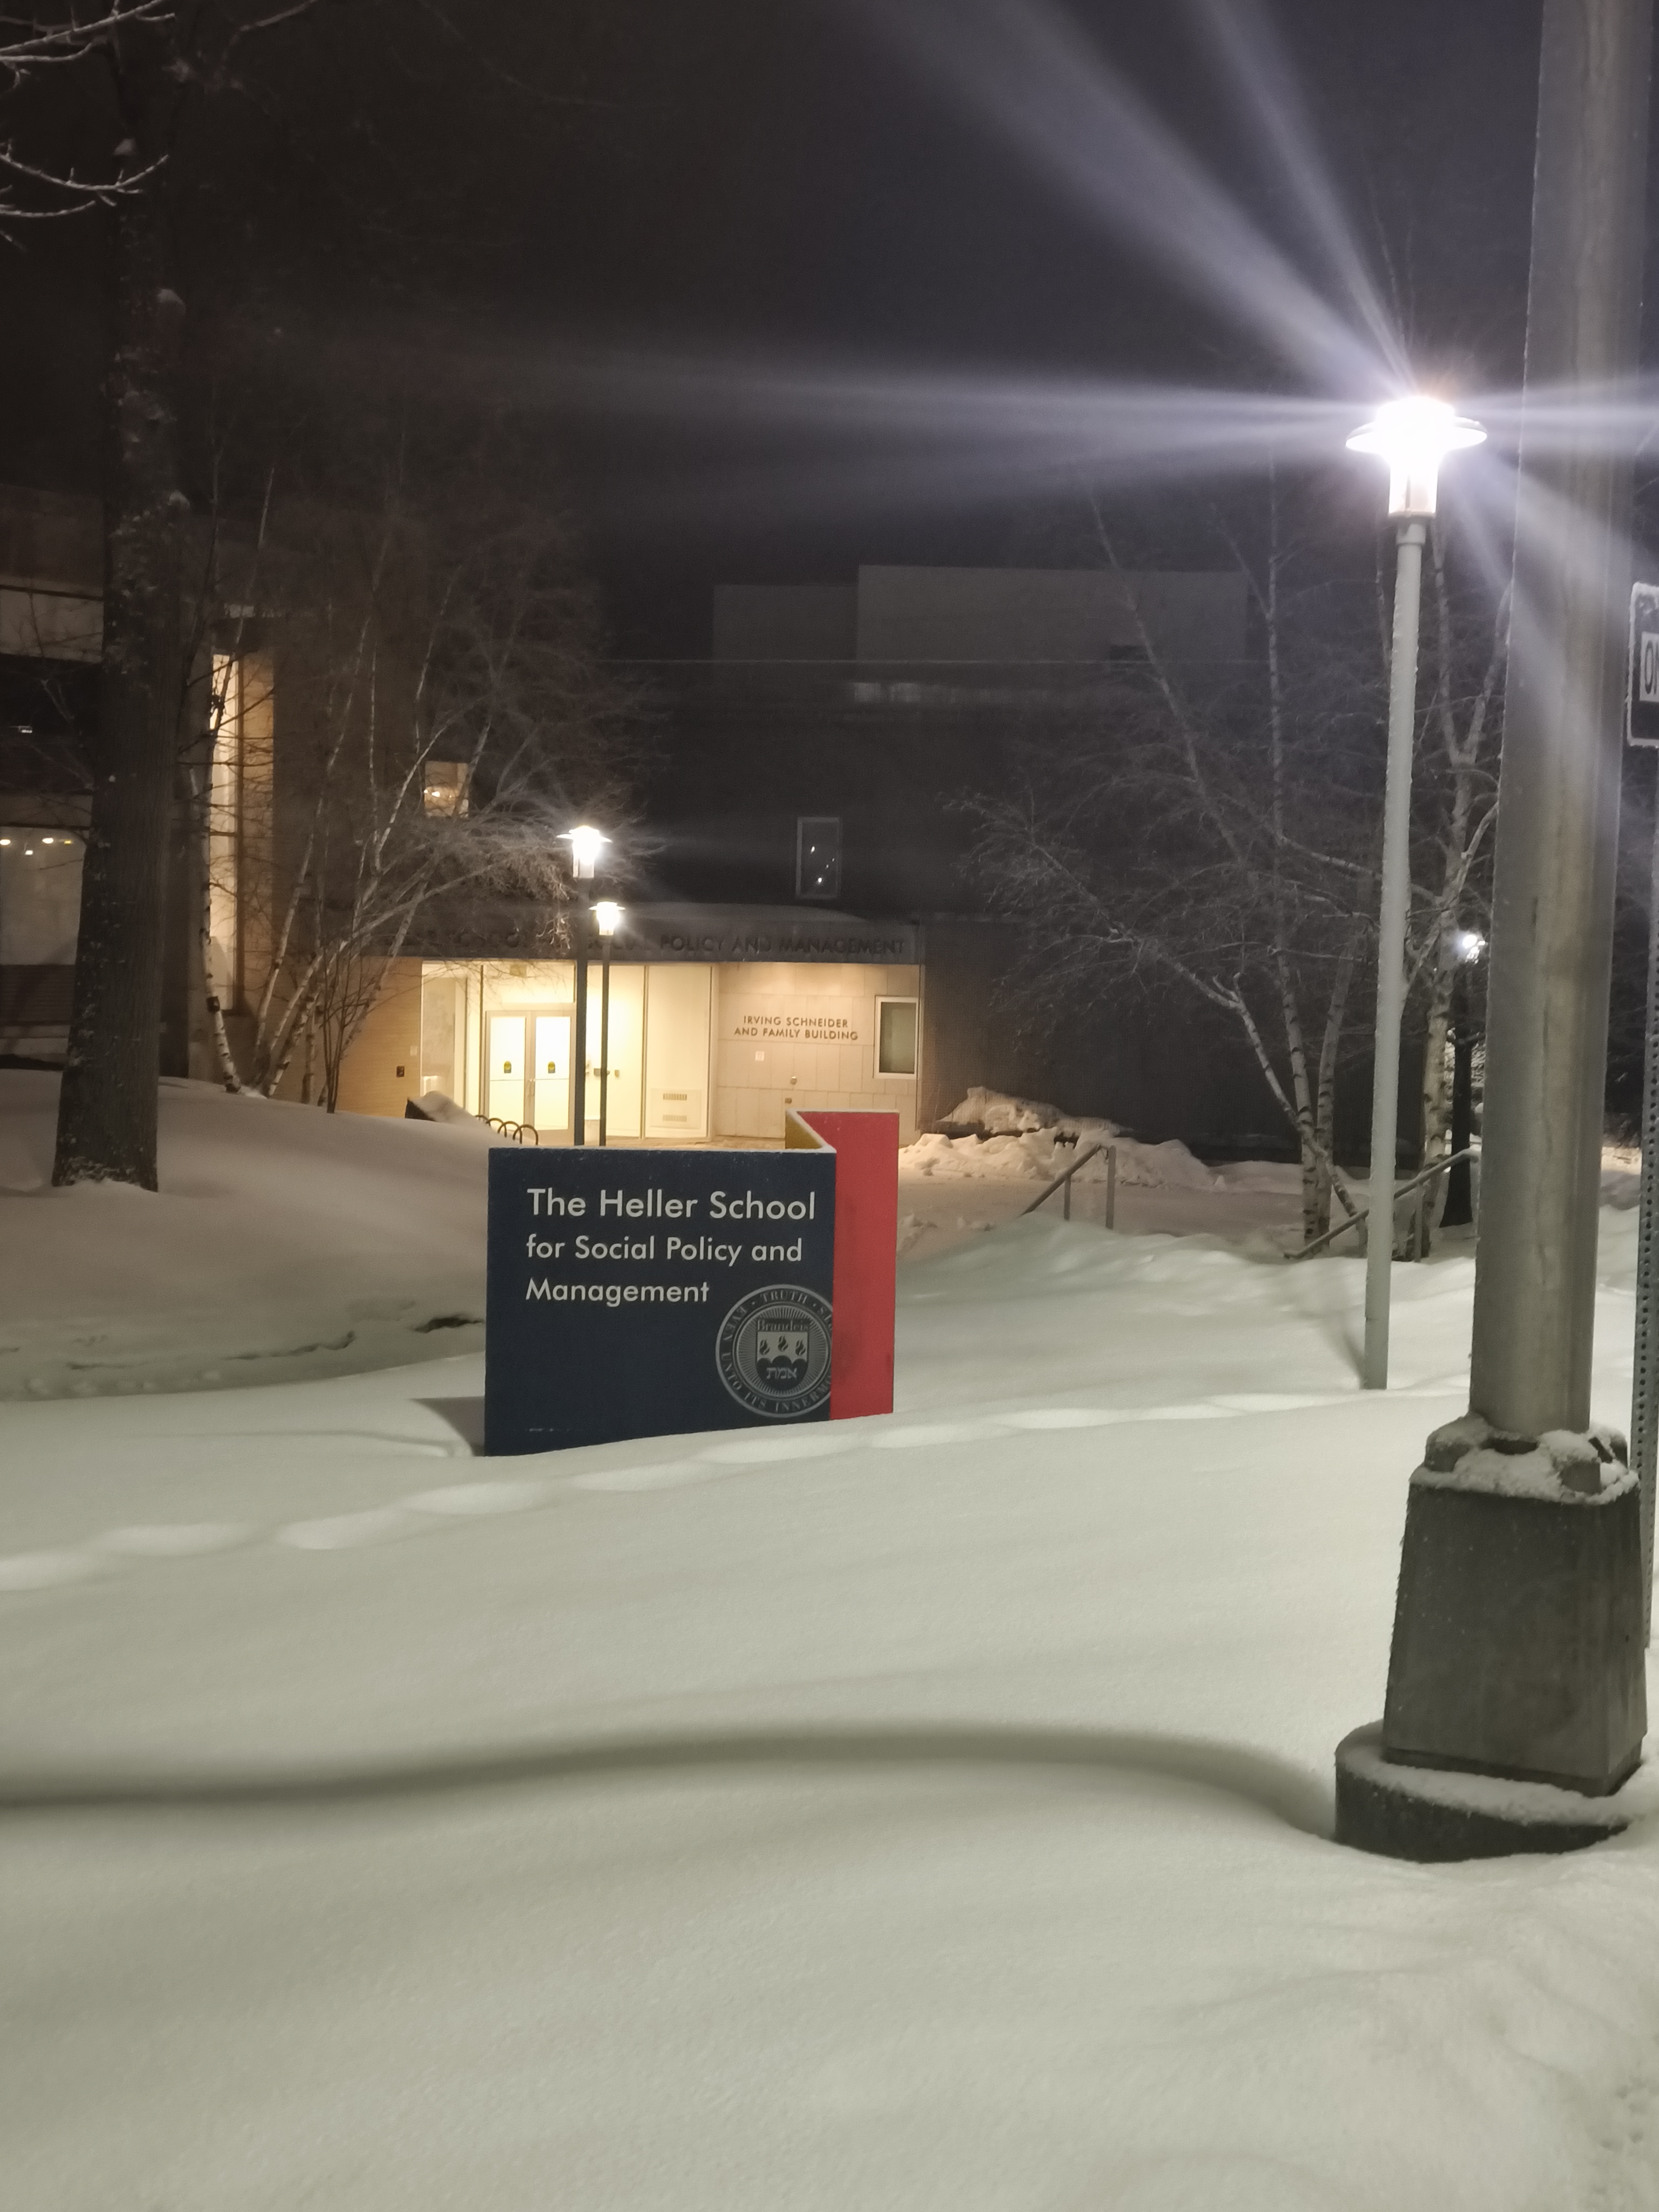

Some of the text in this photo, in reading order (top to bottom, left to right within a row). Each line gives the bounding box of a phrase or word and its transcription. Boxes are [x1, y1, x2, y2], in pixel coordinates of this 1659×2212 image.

[659, 934, 726, 952] POLICY
[731, 936, 772, 953] AND
[778, 937, 906, 954] MANAGEMENT
[744, 1015, 848, 1028] IRVING SCHNEIDER
[734, 1027, 859, 1041] AND FAMILY BUILDING
[527, 1188, 815, 1220] The Heller School
[526, 1233, 802, 1267] for Social Policy and
[525, 1278, 710, 1307] Management
[759, 1289, 808, 1305] TRUTH
[757, 1319, 809, 1332] Brandeis
[721, 1351, 743, 1391] UNTO
[744, 1391, 766, 1409] ITS
[766, 1367, 798, 1380] אמת
